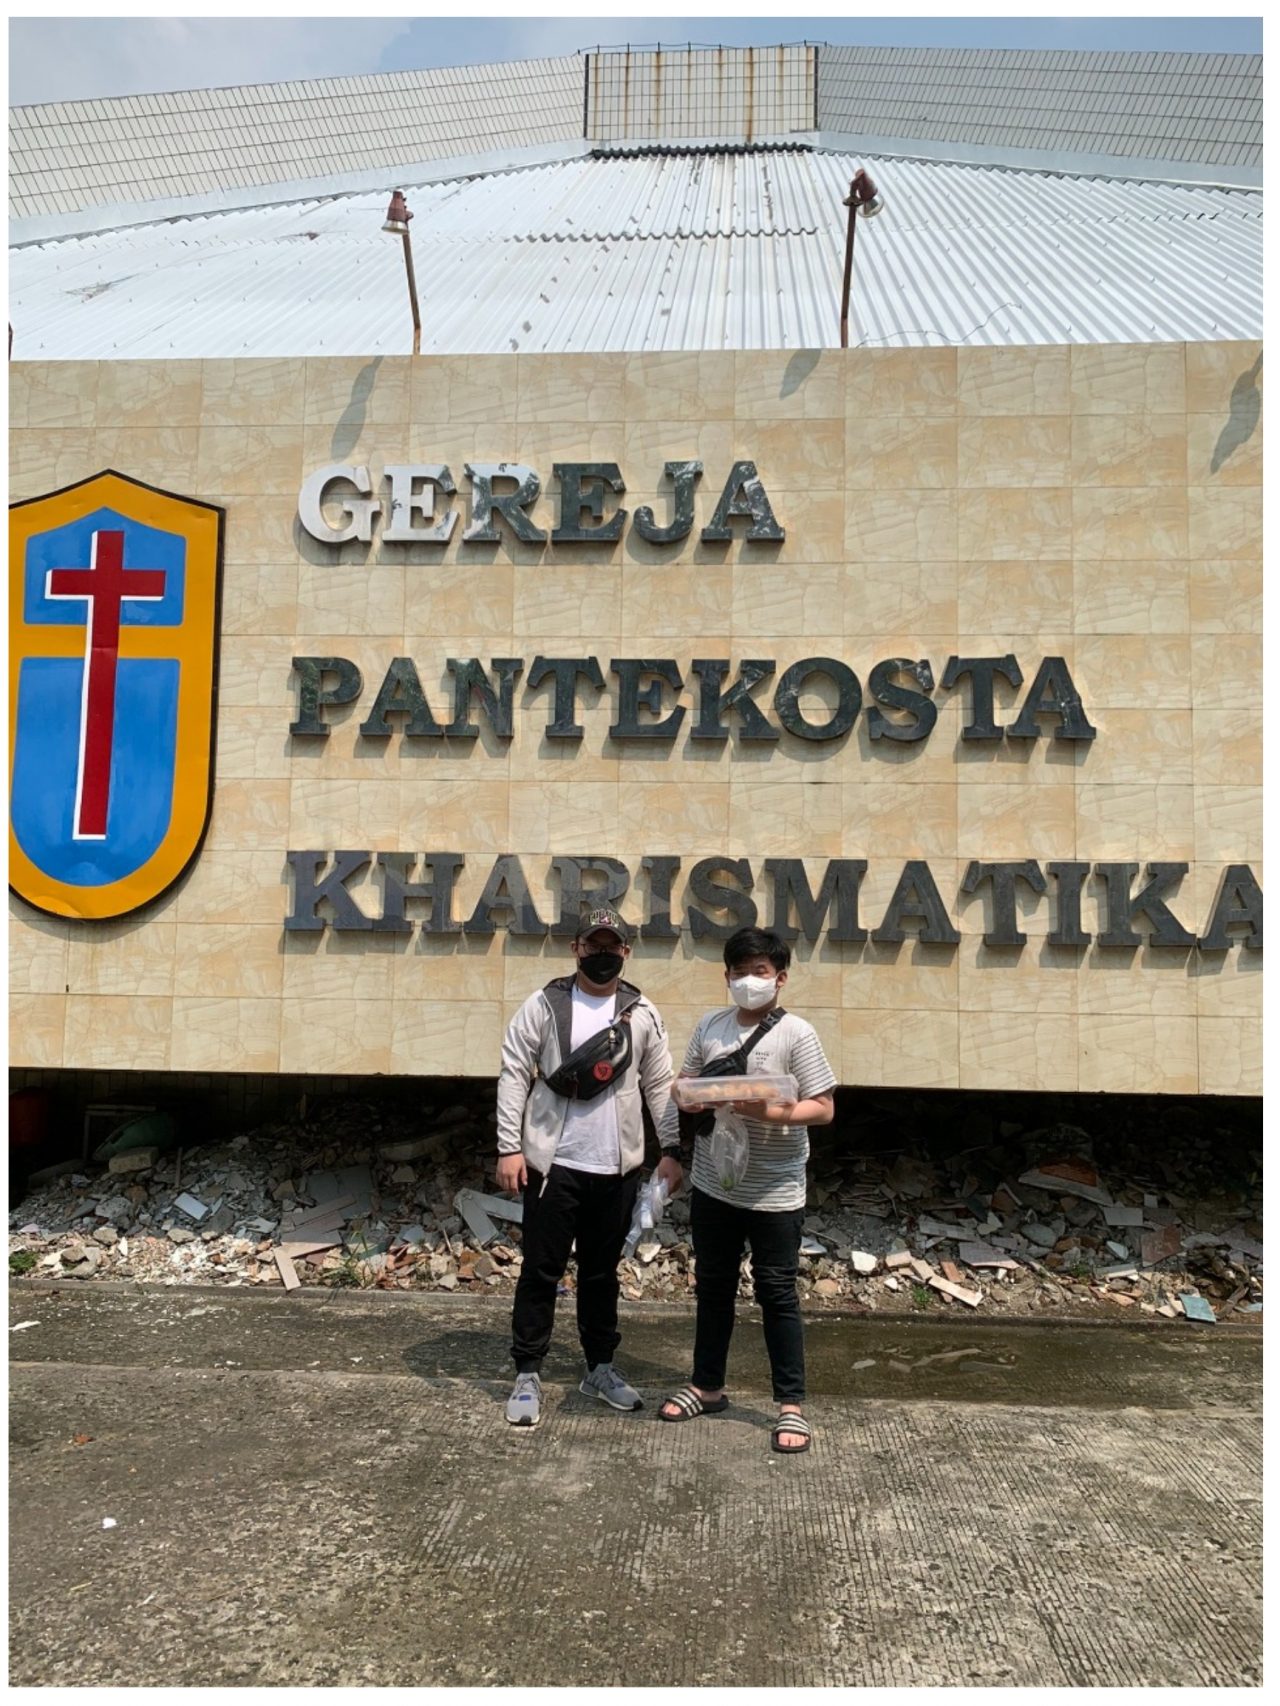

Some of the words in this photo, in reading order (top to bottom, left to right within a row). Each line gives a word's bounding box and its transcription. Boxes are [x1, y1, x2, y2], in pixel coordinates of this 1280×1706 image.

[298, 460, 786, 545] GEREJA
[289, 655, 1096, 741] PANTEKOSTA
[284, 850, 1263, 950] KHARISMATIKA
